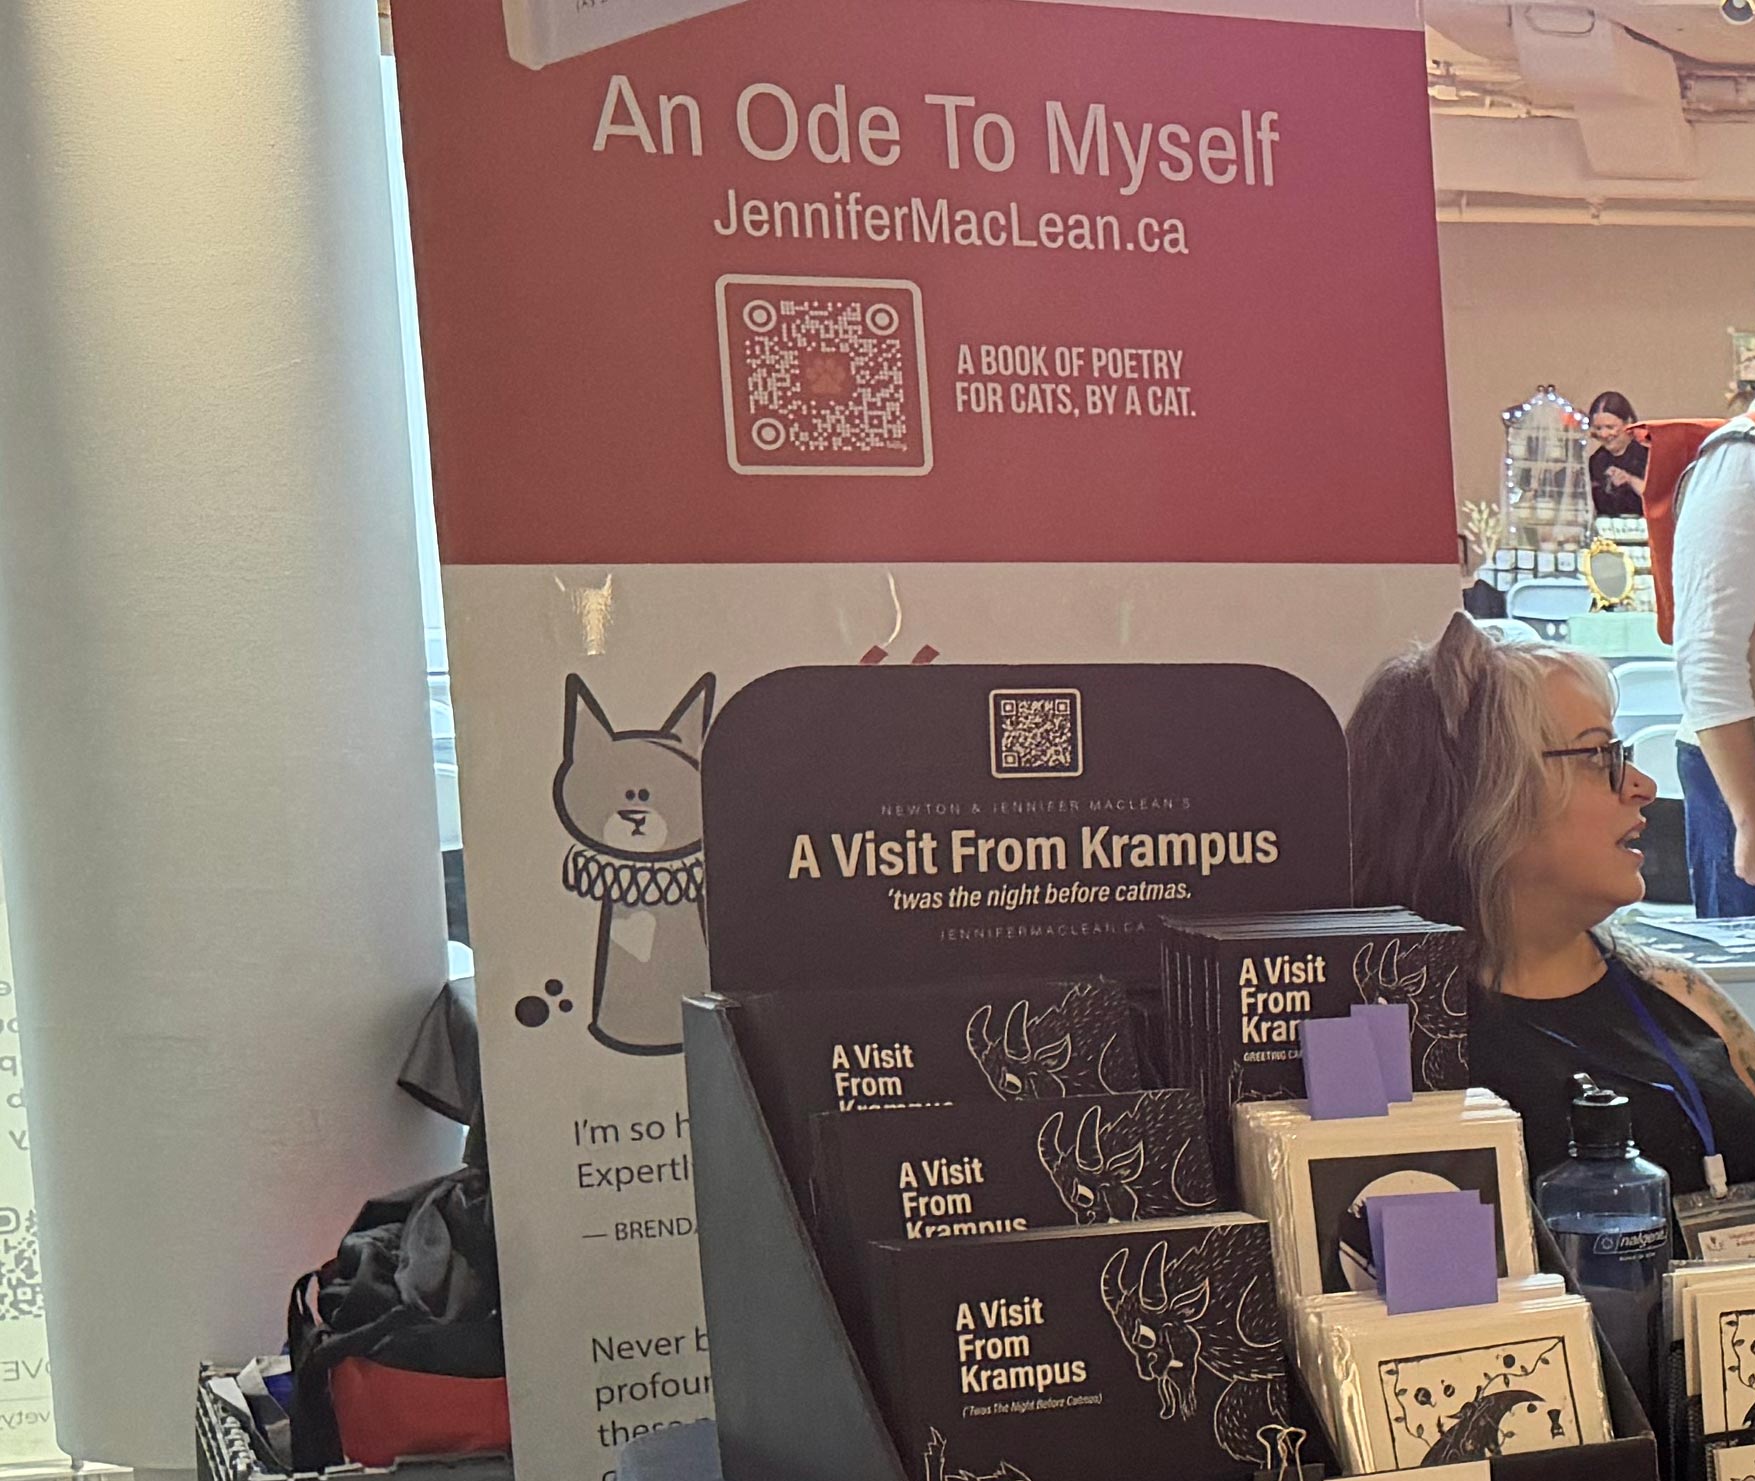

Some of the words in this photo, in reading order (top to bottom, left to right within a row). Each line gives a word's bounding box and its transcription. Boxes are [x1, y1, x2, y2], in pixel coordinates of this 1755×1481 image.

[593, 73, 704, 157] An
[735, 83, 902, 168] Ode
[925, 93, 1015, 172] To
[1046, 100, 1283, 196] Myself
[713, 187, 1191, 257] JenniferMacLean.ca
[957, 344, 975, 375] A
[980, 344, 1049, 376] BOOK
[1055, 347, 1085, 377] OF
[1092, 348, 1183, 379] POETRY
[955, 381, 1004, 413] FOR
[1009, 382, 1080, 418] CATS,
[1086, 384, 1118, 415] BY
[1125, 385, 1142, 416] A
[1147, 386, 1197, 416] CAT.
[881, 802, 960, 816] NEWTON
[788, 834, 821, 879] A
[831, 829, 938, 878] Visit
[950, 829, 1067, 874] From
[1081, 824, 1280, 877] Krampus
[948, 886, 982, 909] the
[987, 884, 1040, 915] night
[1045, 882, 1112, 906] before
[1239, 957, 1258, 986] A
[1264, 954, 1326, 984] Visit
[1241, 987, 1310, 1015] From
[832, 1044, 850, 1069] A
[853, 1043, 914, 1069] Visit
[835, 1072, 902, 1097] From
[574, 1119, 619, 1146] I'm
[631, 1121, 665, 1141] so
[578, 1154, 693, 1192] Expertl
[899, 1162, 918, 1189] A
[922, 1157, 984, 1187] Visit
[902, 1192, 973, 1218] From
[615, 1217, 698, 1241] BREND
[956, 1302, 975, 1332] A
[980, 1296, 1045, 1329] Visit
[592, 1336, 686, 1363] Never
[958, 1334, 1030, 1362] From
[961, 1360, 1087, 1393] Krampus
